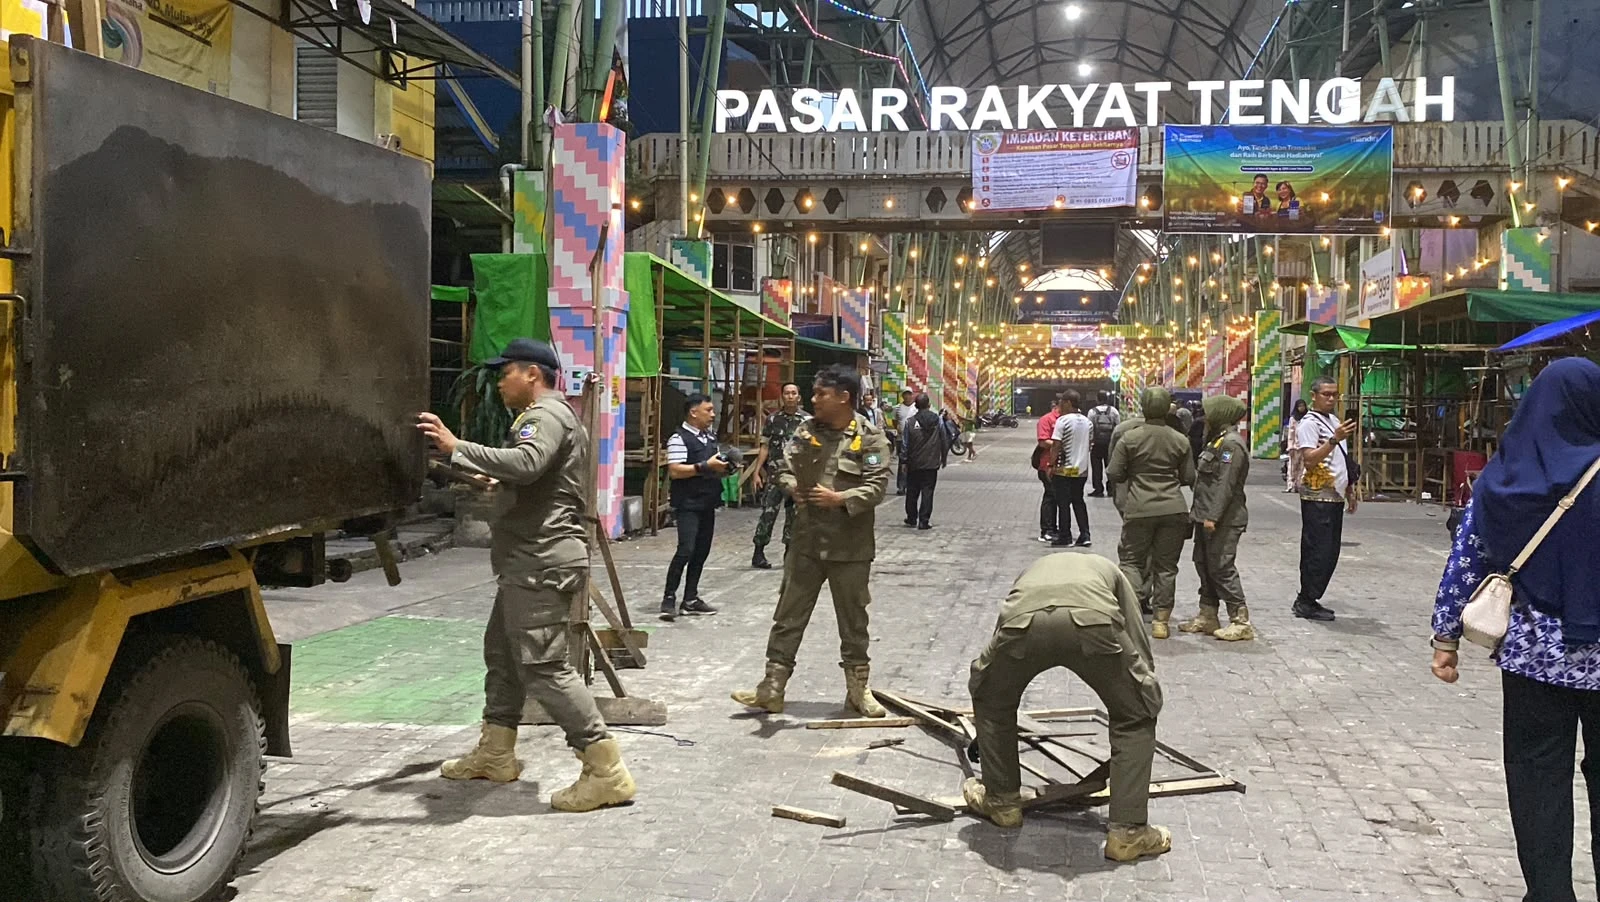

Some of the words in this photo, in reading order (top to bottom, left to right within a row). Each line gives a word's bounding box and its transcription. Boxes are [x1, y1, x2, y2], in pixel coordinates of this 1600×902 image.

[715, 87, 909, 133] PASAR
[931, 81, 1171, 130] RAKYAT
[1188, 76, 1454, 127] TENGAH
[1006, 132, 1059, 145] IMBAUAN
[1062, 130, 1132, 142] KETERTIBAN
